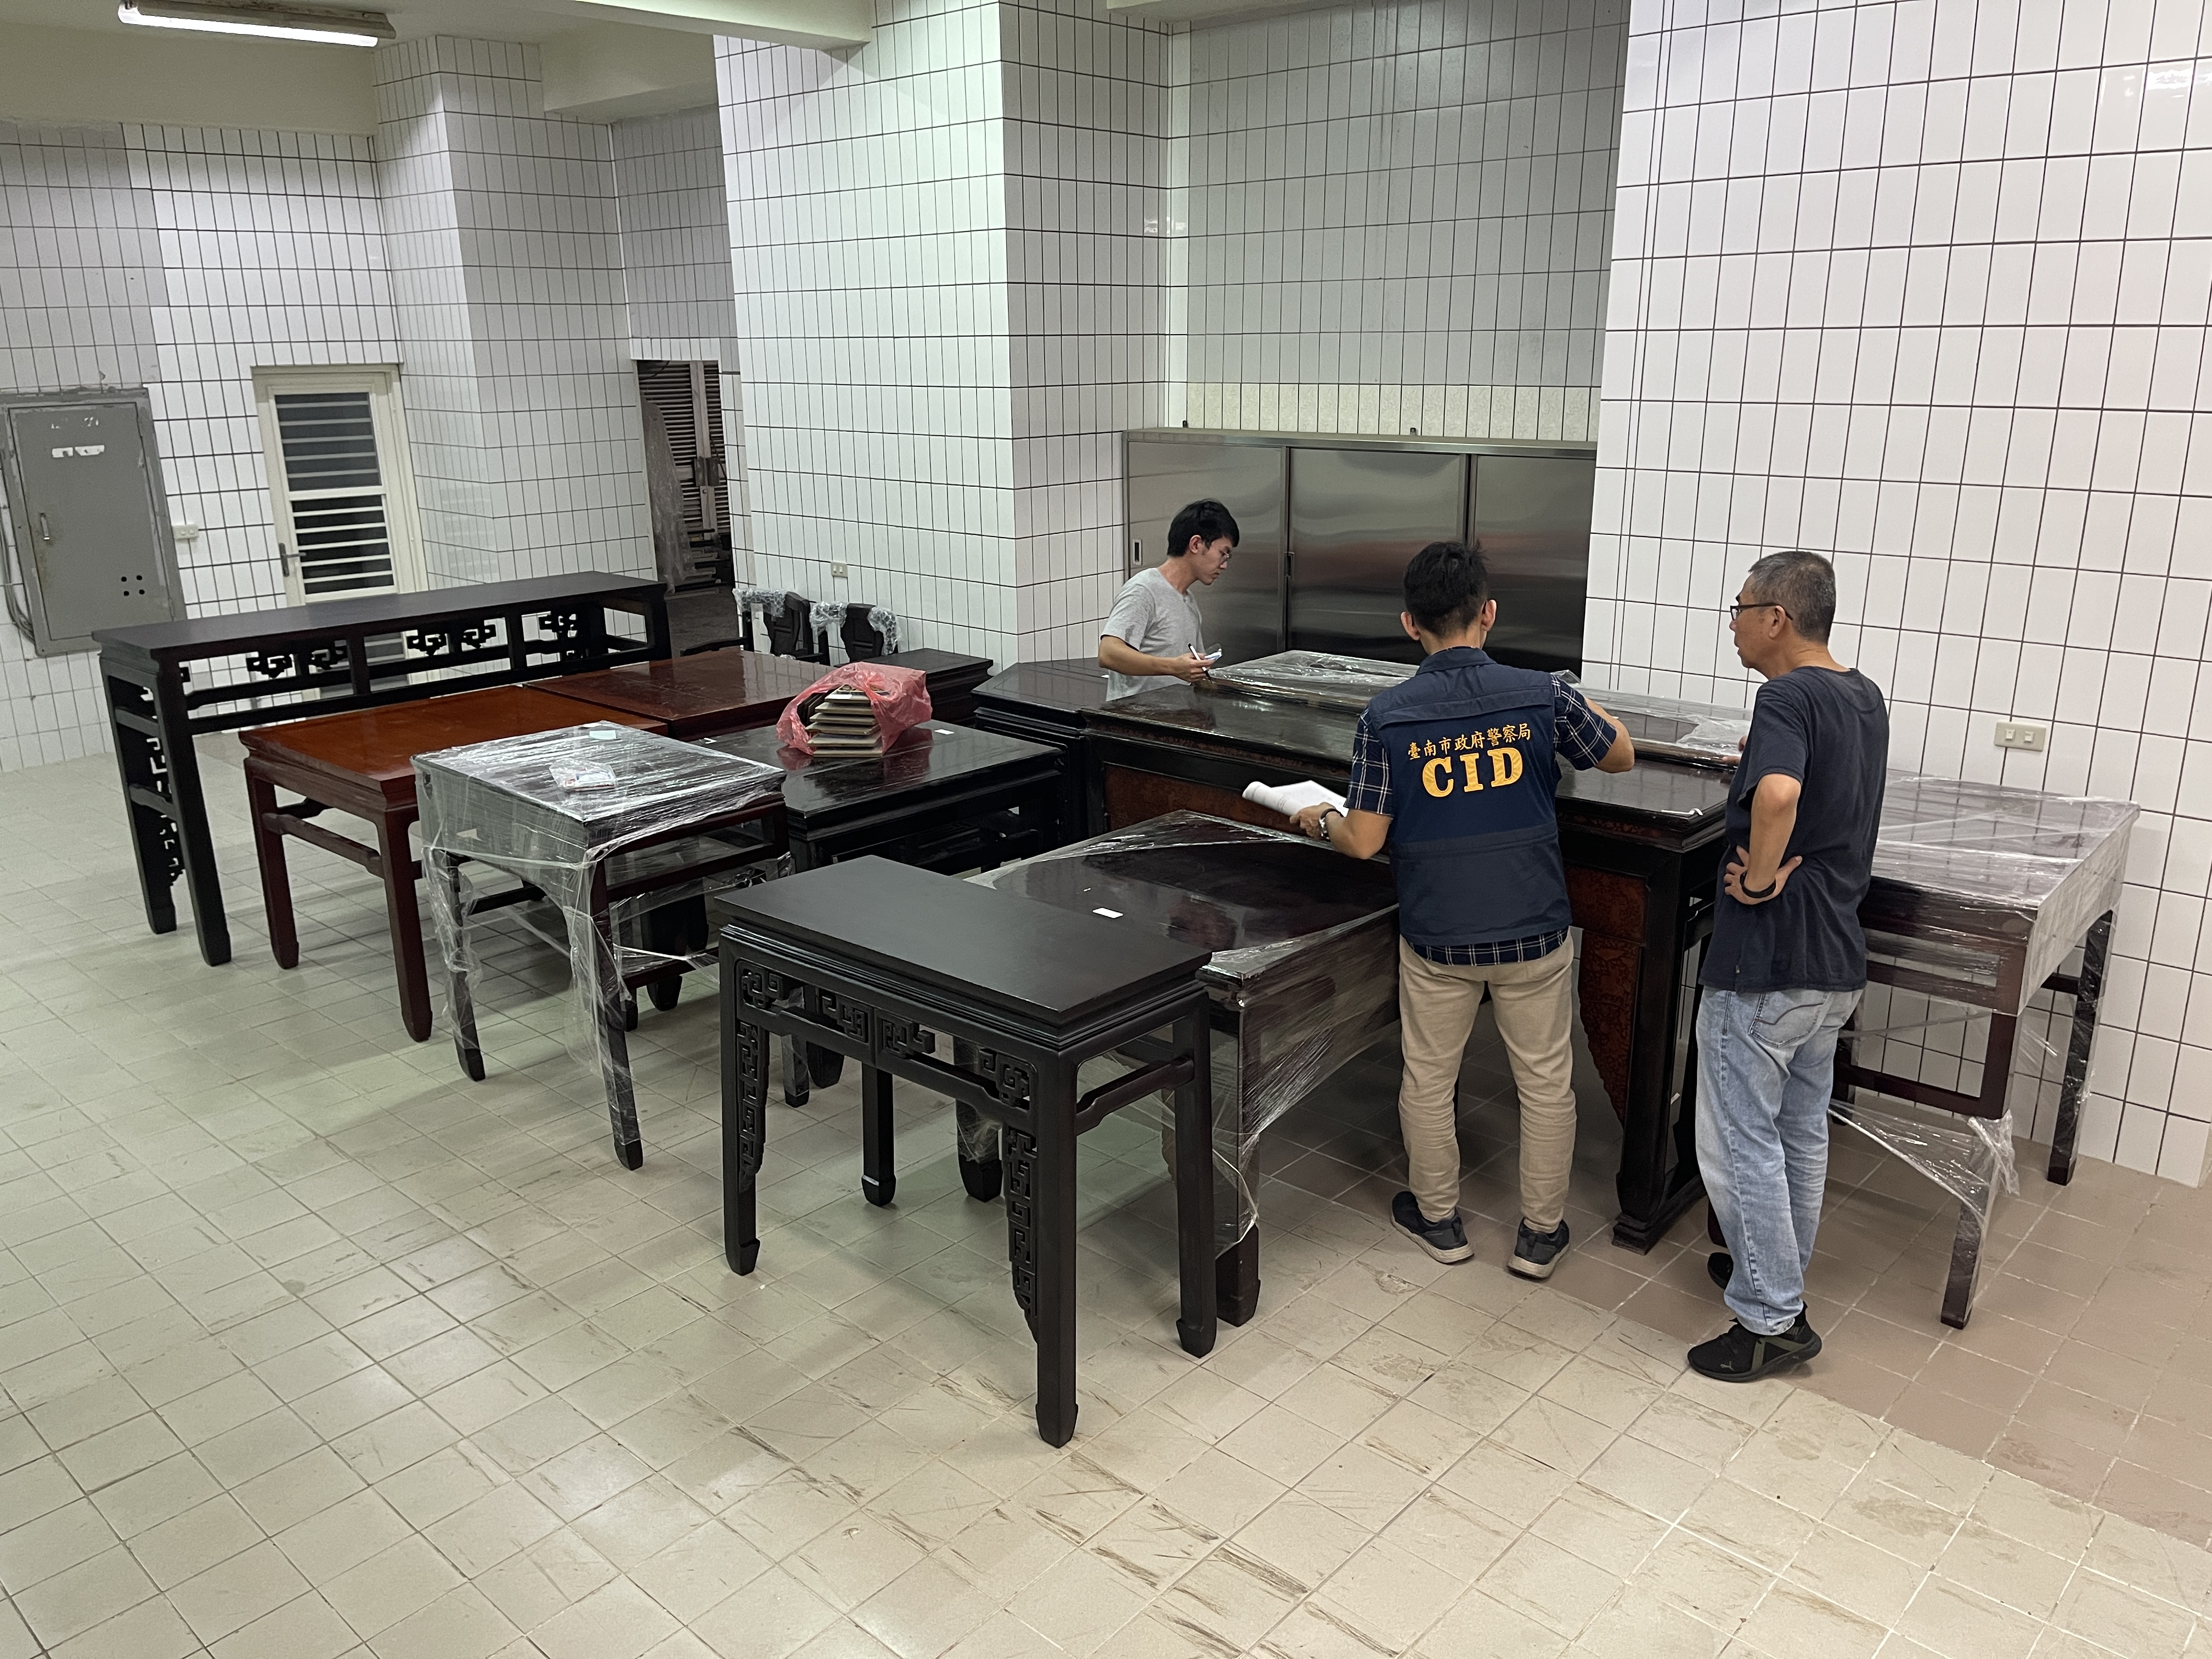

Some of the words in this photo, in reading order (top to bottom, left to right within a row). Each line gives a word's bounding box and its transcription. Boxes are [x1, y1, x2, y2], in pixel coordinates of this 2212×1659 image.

[1408, 723, 1531, 760] 臺南市政府警察局
[1421, 746, 1523, 798] CID
